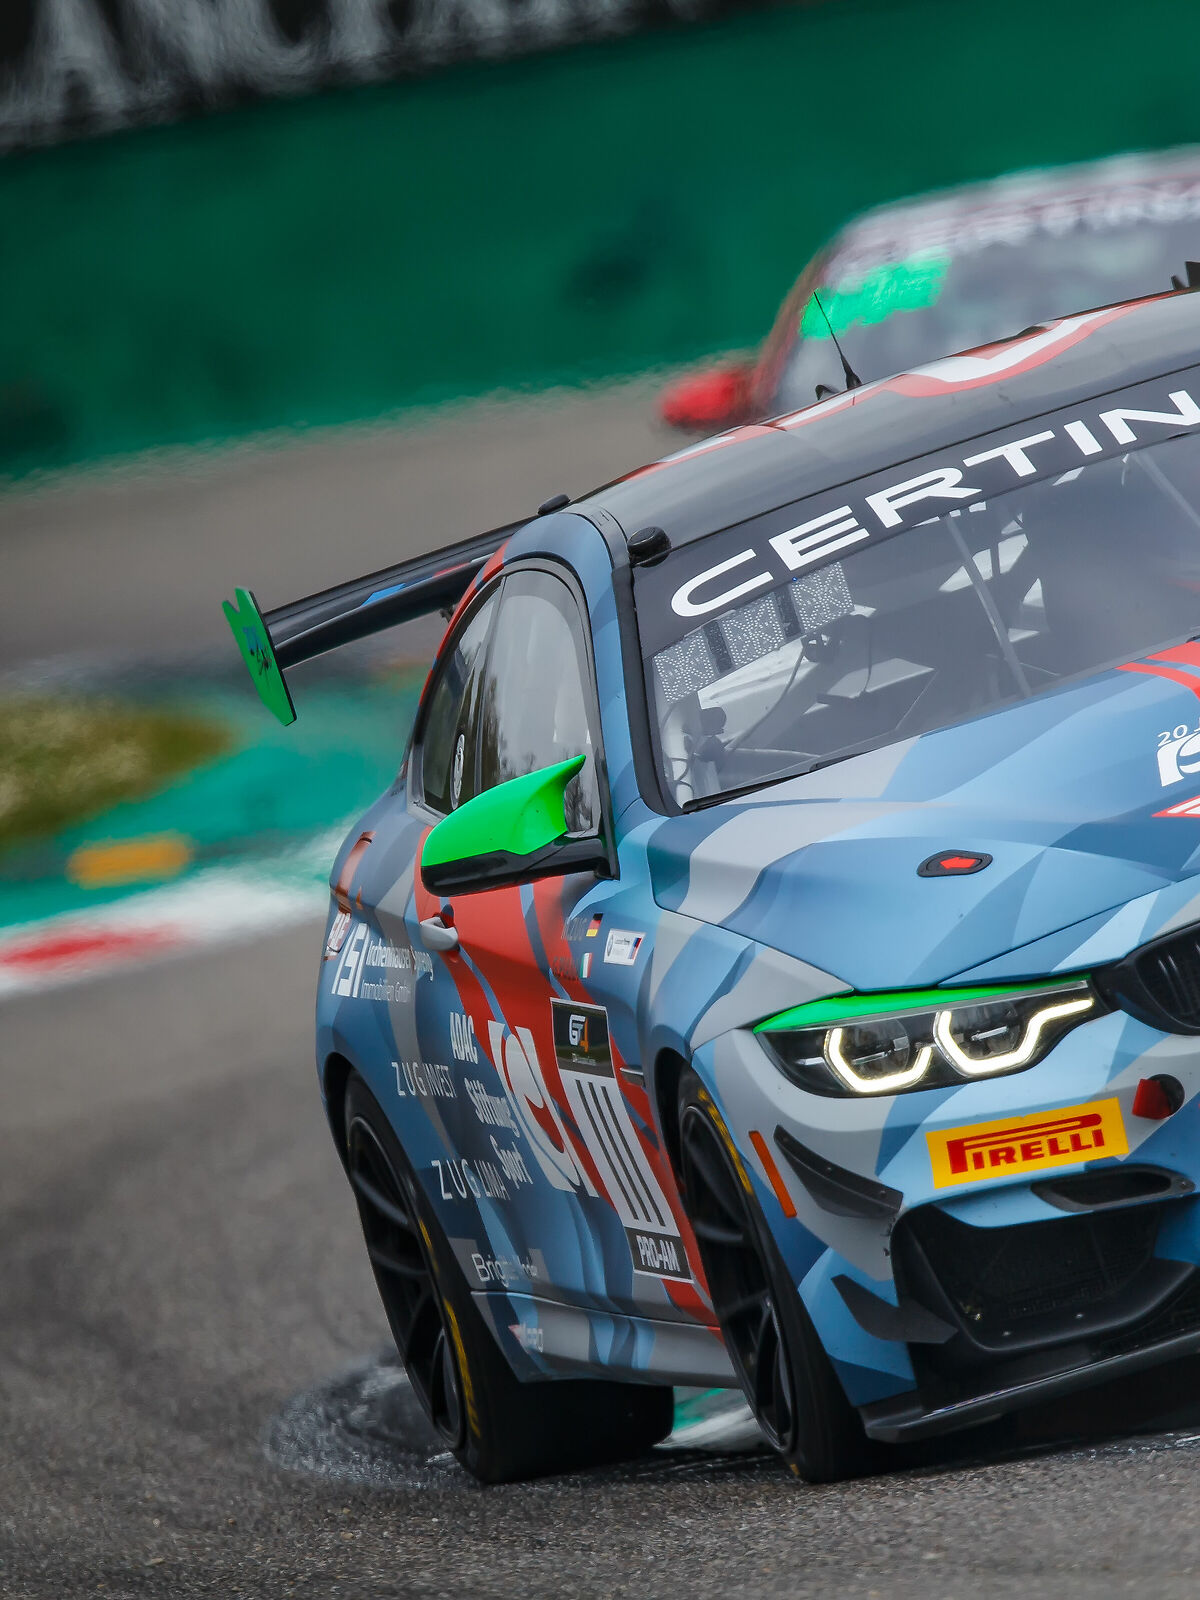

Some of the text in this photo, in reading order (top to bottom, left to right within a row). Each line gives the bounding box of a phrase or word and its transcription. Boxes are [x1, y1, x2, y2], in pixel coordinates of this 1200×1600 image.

[1156, 723, 1188, 748] 20
[450, 1012, 479, 1065] ADAC
[391, 1061, 458, 1098] ZUG INVEST
[464, 1077, 520, 1138] Stiftung
[489, 1134, 534, 1190] Sport
[946, 1113, 1105, 1175] PIRELLI
[431, 1159, 481, 1200] ZUG
[635, 1234, 681, 1273] PRO-AM
